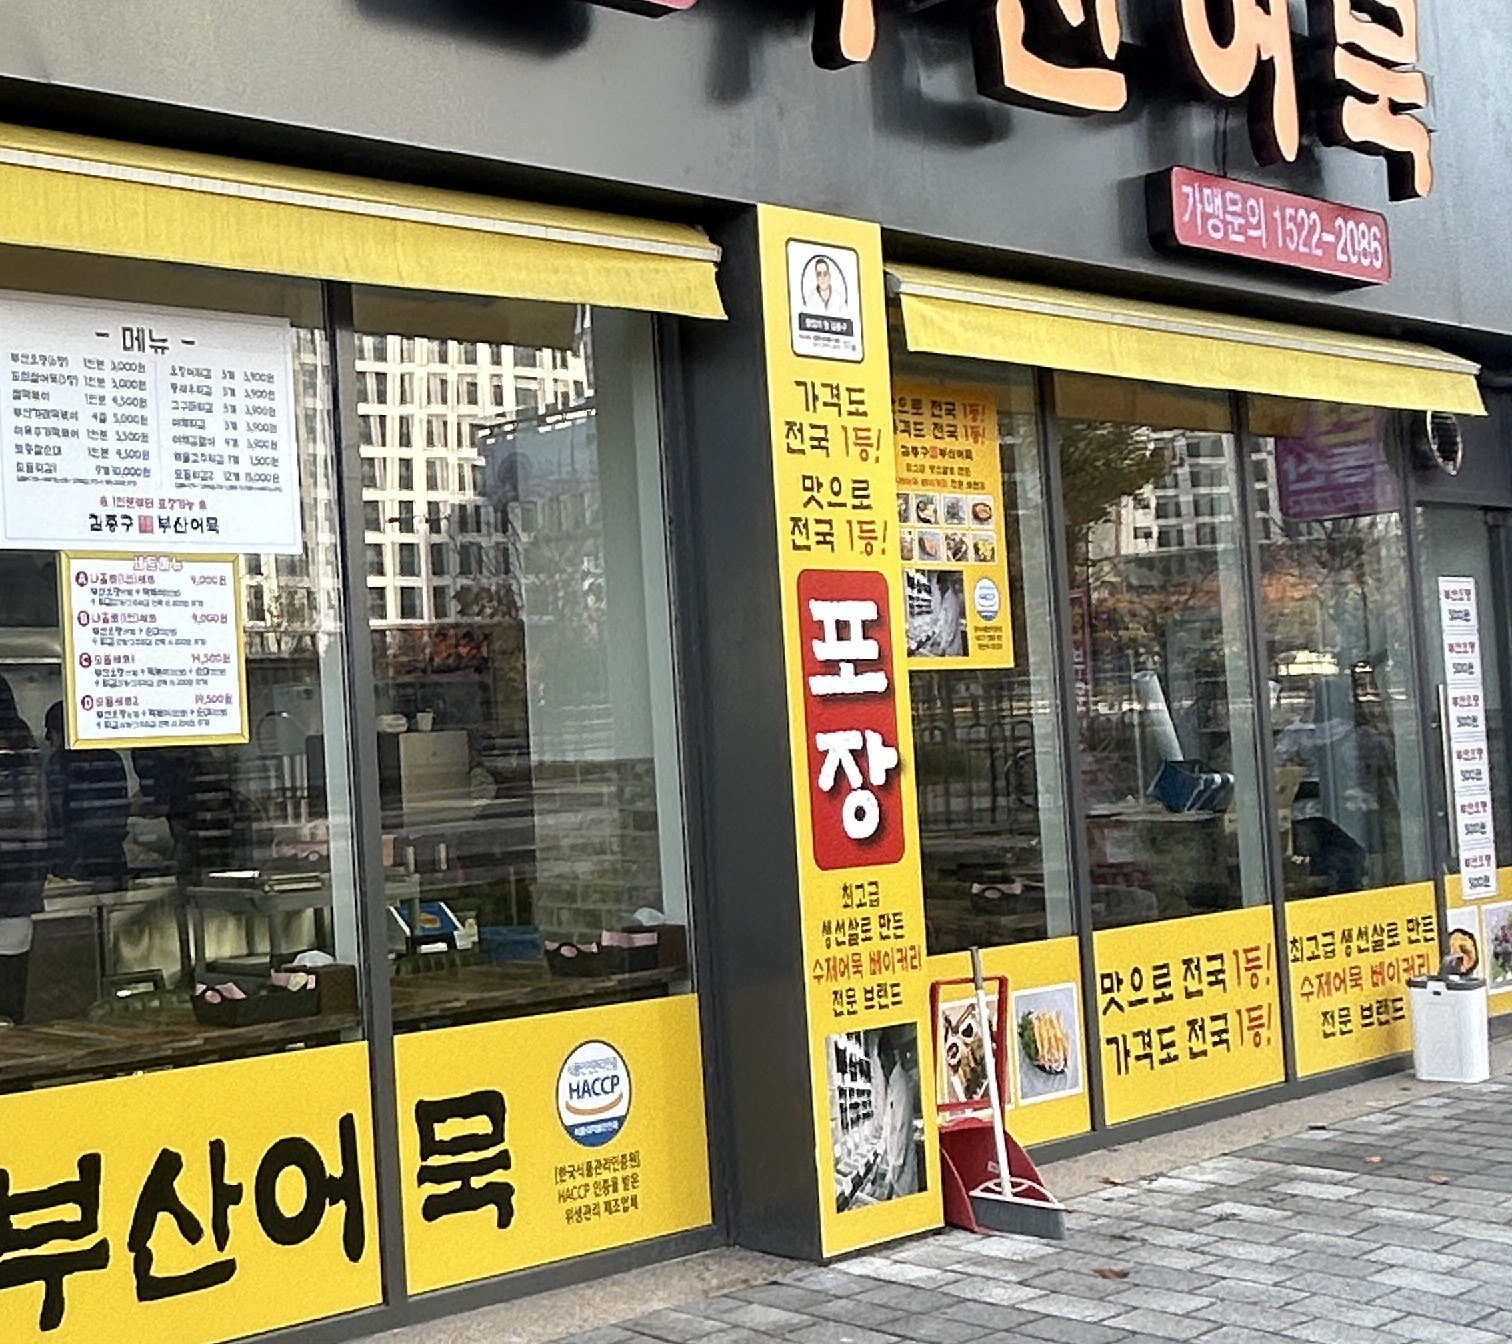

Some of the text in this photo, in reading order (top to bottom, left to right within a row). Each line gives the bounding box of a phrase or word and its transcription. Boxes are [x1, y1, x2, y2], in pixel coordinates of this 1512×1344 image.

[1180, 182, 1268, 249] 가맹문의
[121, 326, 170, 356] 메뉴
[794, 379, 869, 419] 가격도
[784, 420, 883, 465] 전국 1등!
[801, 473, 874, 511] 맛으로
[89, 513, 220, 534] 김종구 부산어묵
[789, 516, 888, 557] 전국 1등!
[808, 598, 899, 840] 포장
[841, 880, 881, 911] 최고급
[821, 911, 906, 950] 생선살로 만든
[1290, 914, 1437, 964] 최고급 생선살로 만든
[812, 944, 923, 985] 수제어묵 베이커리
[1100, 942, 1272, 1016] 맛으로 전국 1등!
[1299, 952, 1432, 1003] 수제어묵 베이커리
[831, 982, 904, 1018] 전문 브랜드
[1320, 996, 1407, 1040] 전문 브랜드
[1105, 1002, 1273, 1076] 가격도 전국 1등!
[568, 1074, 621, 1100] HACCP
[557, 1182, 591, 1205] HACCP
[565, 1202, 602, 1225] 위생관리
